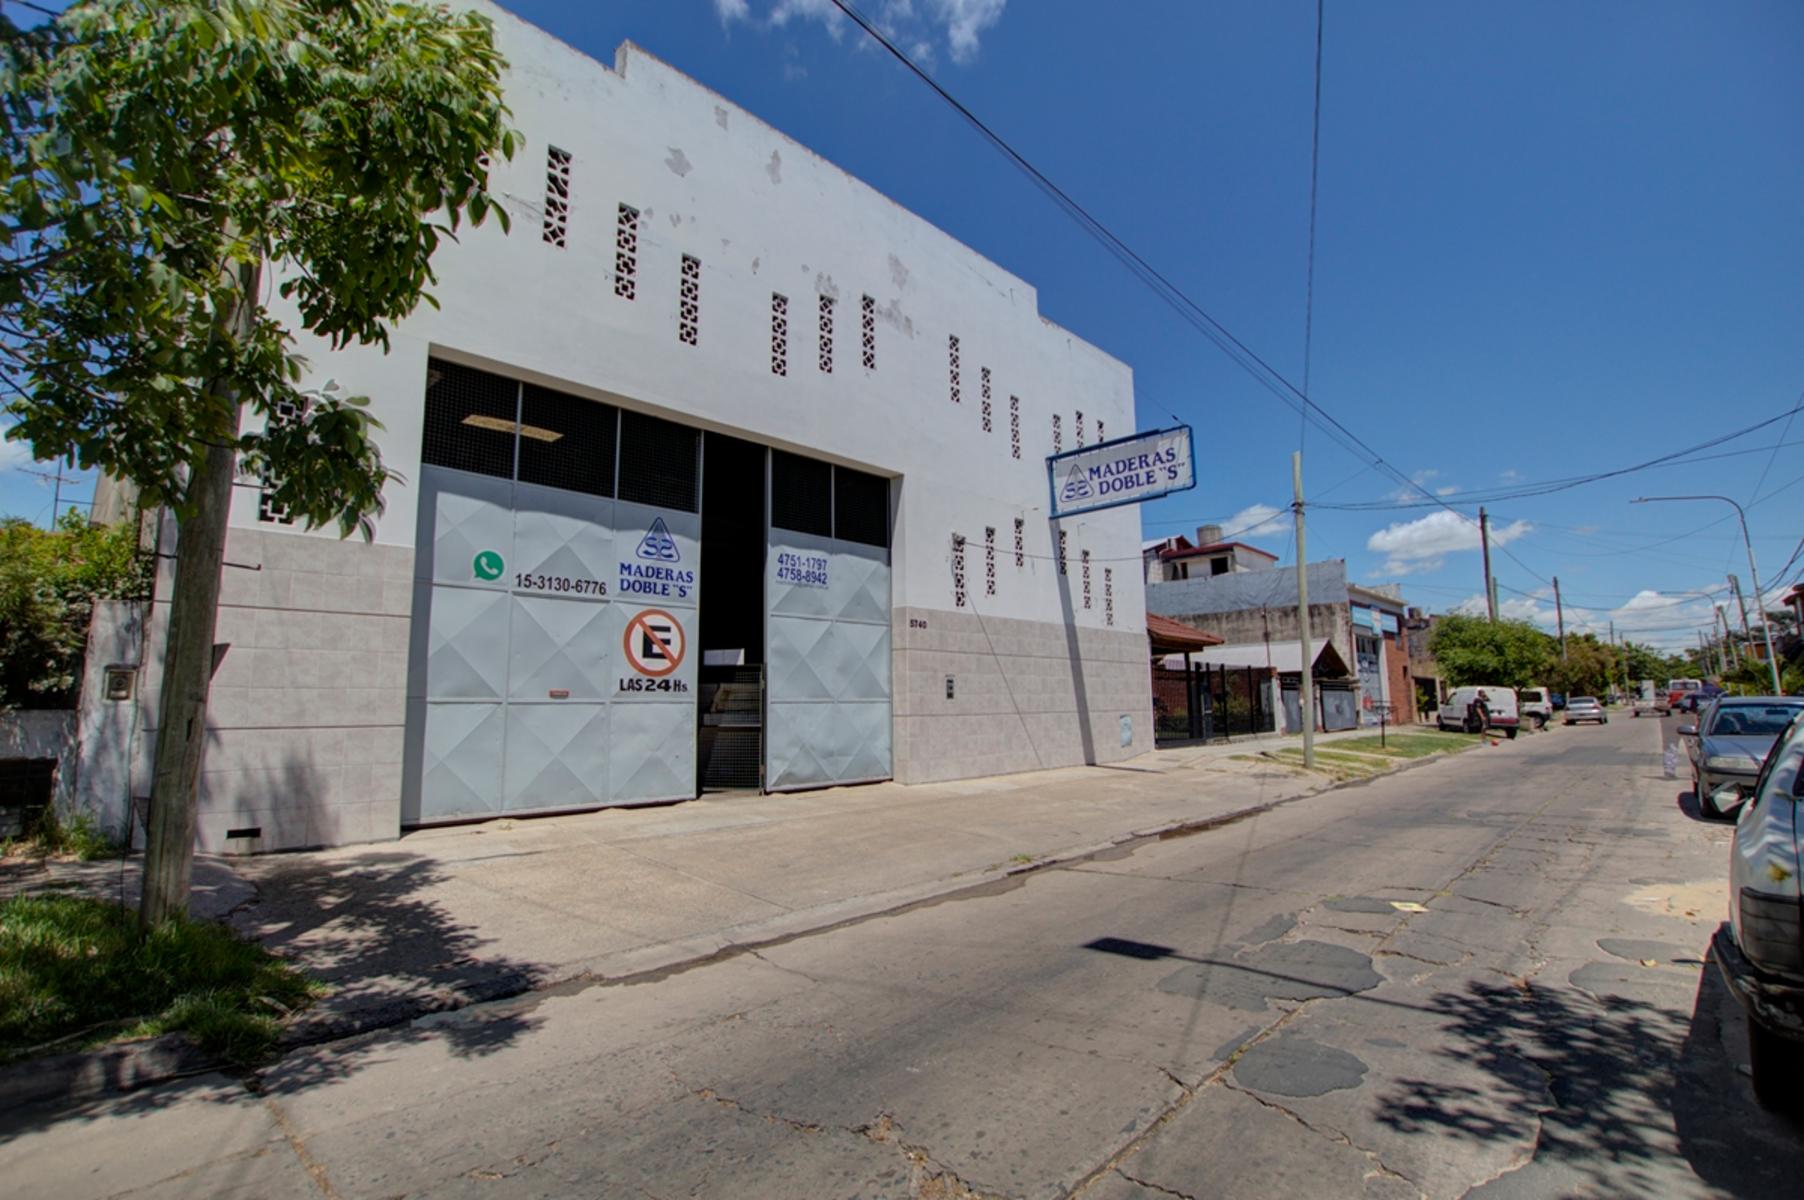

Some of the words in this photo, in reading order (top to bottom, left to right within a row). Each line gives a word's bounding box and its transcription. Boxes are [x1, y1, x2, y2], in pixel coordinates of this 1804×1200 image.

[1088, 447, 1176, 481] MADERAS
[1099, 469, 1157, 495] DOBLE
[777, 553, 828, 571] 4751-1797
[619, 562, 694, 583] MADERAS
[777, 567, 828, 585] 4758-8942
[515, 573, 607, 596] 15-3130-6776
[619, 578, 671, 597] DOBLE
[619, 678, 643, 692] LAS
[644, 678, 671, 692] 24
